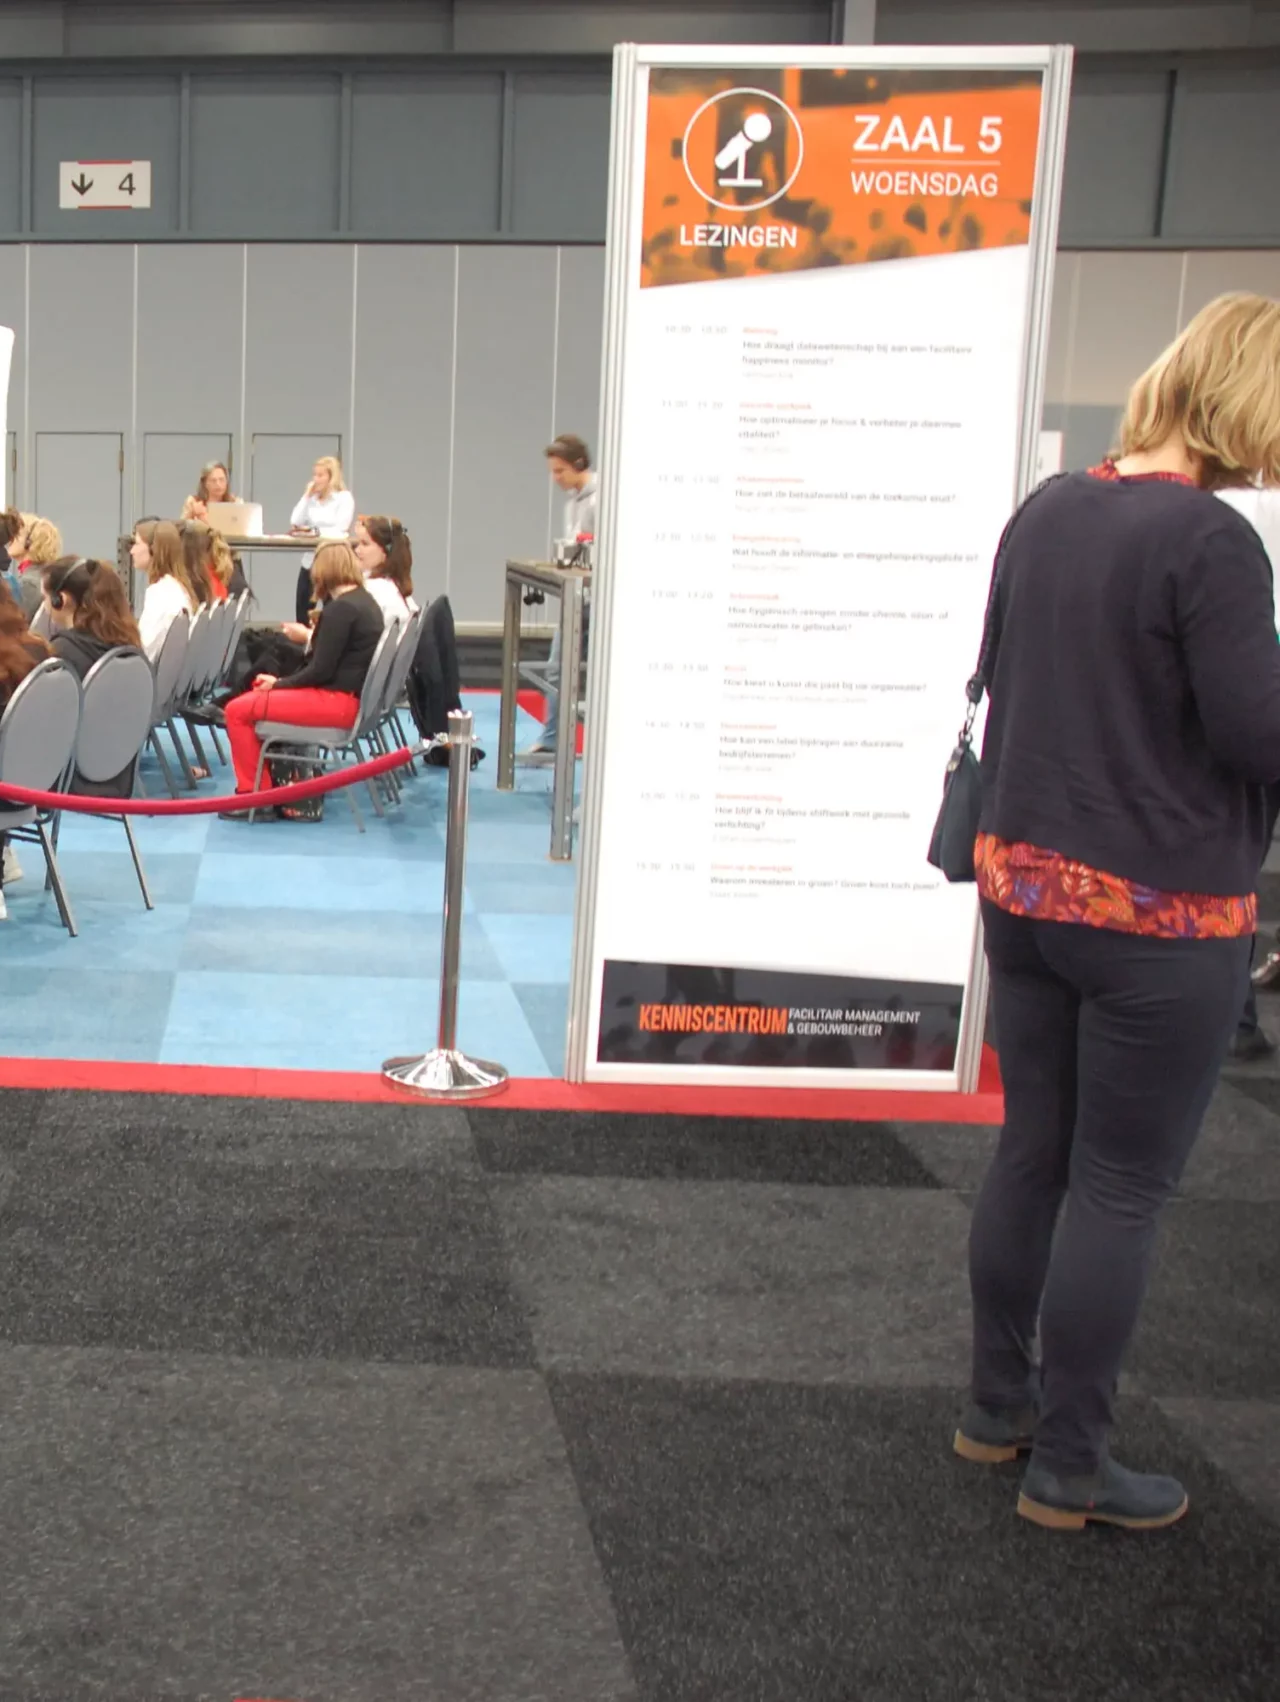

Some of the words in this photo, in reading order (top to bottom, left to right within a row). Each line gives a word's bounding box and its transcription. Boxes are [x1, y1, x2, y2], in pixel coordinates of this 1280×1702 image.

[853, 114, 964, 153] ZAAL
[977, 117, 1002, 153] 5
[118, 172, 136, 195] 4
[850, 170, 999, 197] WOENSDAG
[679, 224, 798, 249] LEZINGEN
[639, 1004, 787, 1035] KENNISCENTRUM
[789, 1008, 843, 1021] FACILITAIR
[844, 1009, 920, 1024] MANAGEMENT
[787, 1023, 794, 1035] &
[797, 1023, 882, 1037] GEBOUWBEHEER
